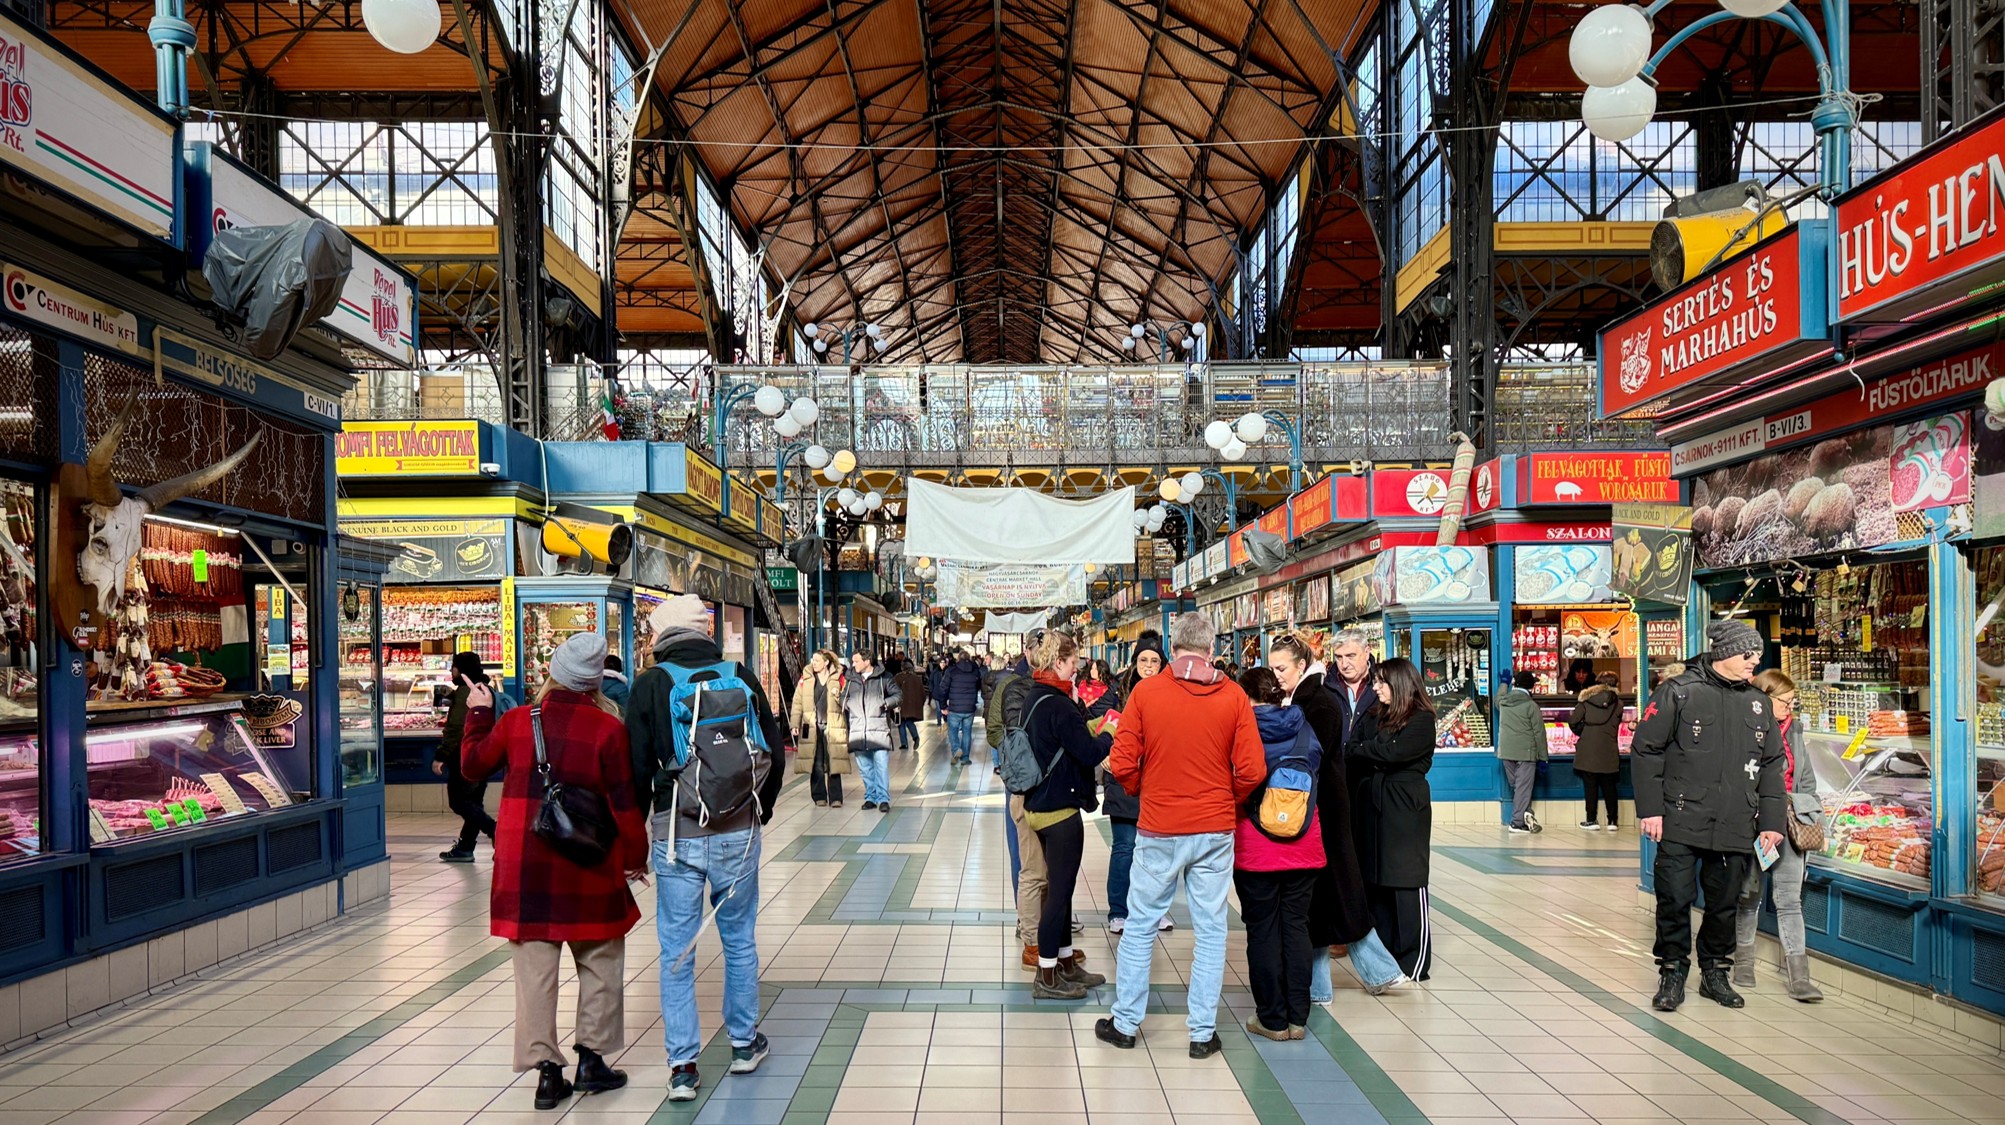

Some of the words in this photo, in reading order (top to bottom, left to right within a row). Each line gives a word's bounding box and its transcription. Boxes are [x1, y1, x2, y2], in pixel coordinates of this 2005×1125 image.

[4, 127, 25, 152] Rt.
[37, 289, 89, 325] CENTRUM
[93, 311, 114, 334] HÚS
[1663, 275, 1733, 338] SERTÉS
[1746, 253, 1773, 299] ÉS
[1660, 296, 1777, 378] MARHAHÚS
[1870, 353, 1991, 412] FÜSTÖLTÁRUK
[335, 431, 372, 458] OMFI
[376, 422, 476, 458] FELVÁGOTTAK
[1674, 435, 1737, 466] CSARNOK-9111
[1739, 428, 1761, 448] KFT.
[1769, 415, 1807, 439] B-VI/3.
[1537, 456, 1623, 479] FELVÁGOTTAK
[382, 525, 409, 534] BLACK
[411, 524, 430, 533] AND
[433, 524, 458, 533] GOLD
